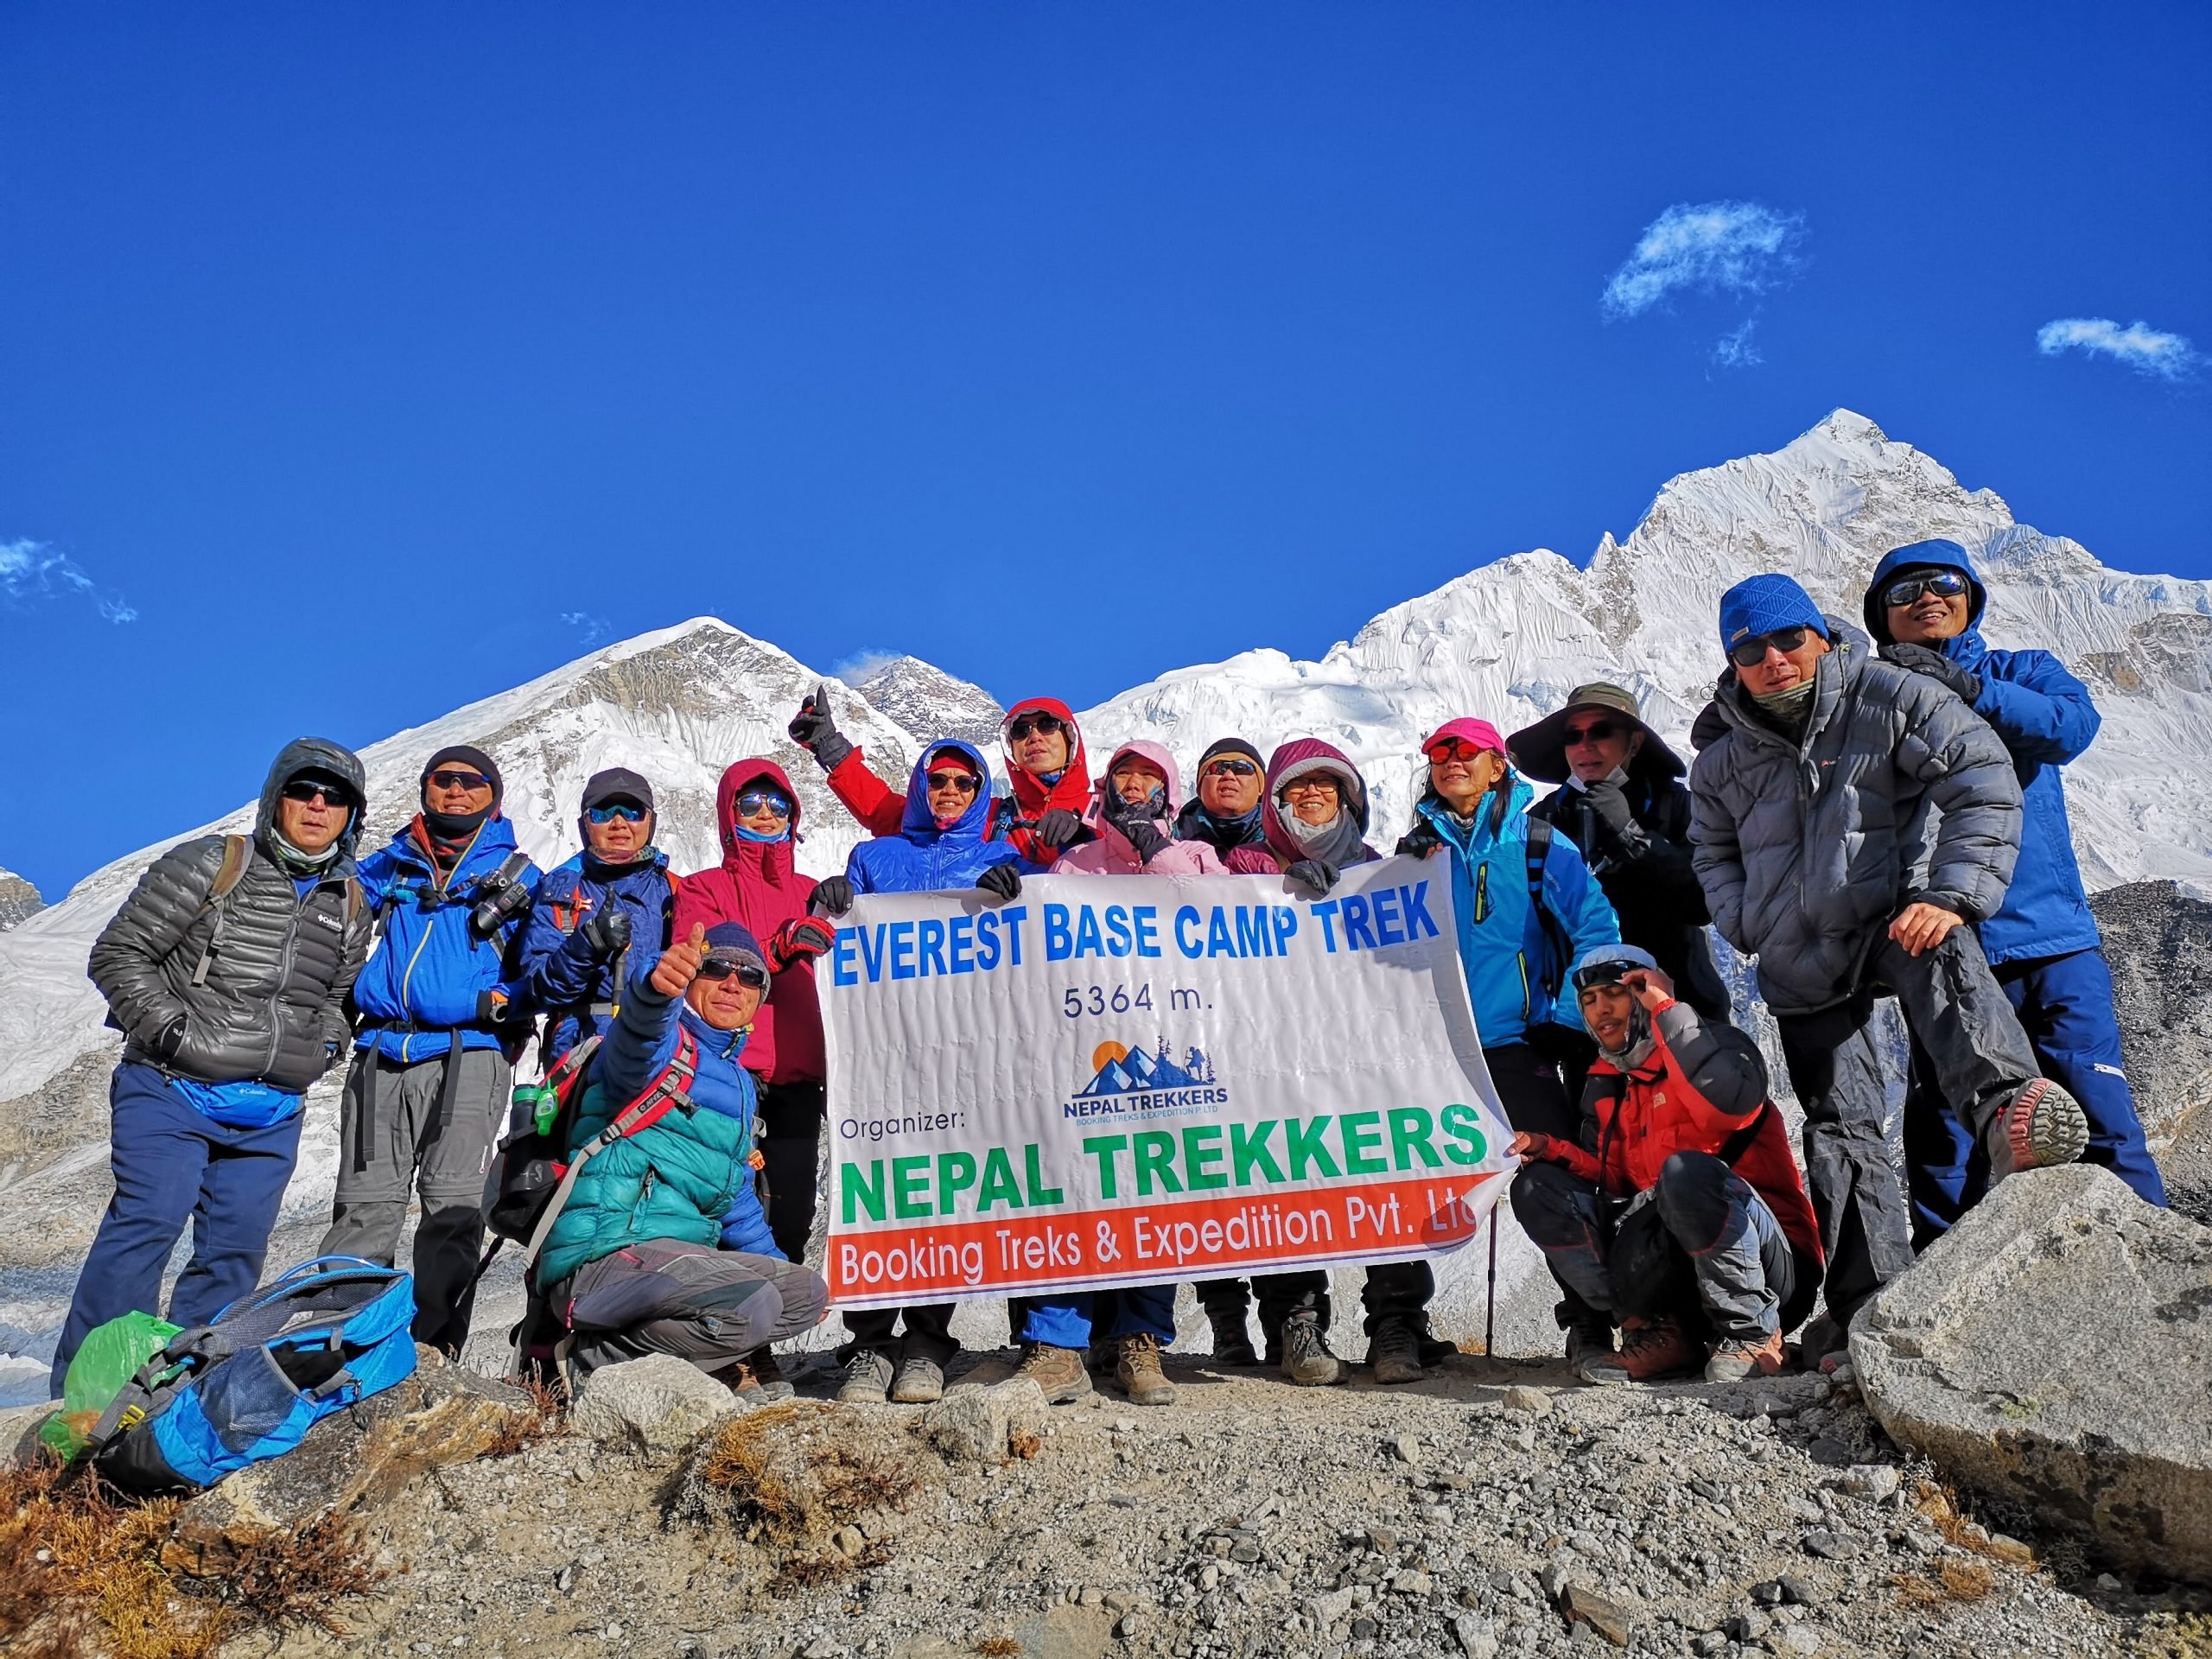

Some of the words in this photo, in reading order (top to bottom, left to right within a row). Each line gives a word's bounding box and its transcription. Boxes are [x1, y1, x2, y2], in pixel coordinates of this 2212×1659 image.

[831, 906, 1027, 987] EVEREST
[1043, 904, 1162, 962] BASE
[1174, 905, 1298, 959] CAMP
[1310, 880, 1440, 953] TREK
[1064, 983, 1154, 1019] 5364
[1170, 988, 1213, 1011] m.
[1064, 1097, 1126, 1118] NEPAL
[1127, 1088, 1229, 1111] TREKKERS
[1076, 1116, 1112, 1127] BOOKING
[1113, 1112, 1139, 1122] TREKS
[1147, 1106, 1195, 1120] EXPEDITION
[1204, 1105, 1218, 1114] LTD
[840, 1112, 966, 1142] Organizer:
[841, 1143, 1065, 1224] NEPAL
[1083, 1103, 1487, 1199] TREKKERS
[841, 1232, 983, 1286] Booking
[995, 1225, 1082, 1271] Treks
[1096, 1220, 1122, 1263] &
[1134, 1205, 1333, 1265] Expedition
[1345, 1192, 1414, 1239] Pvt.
